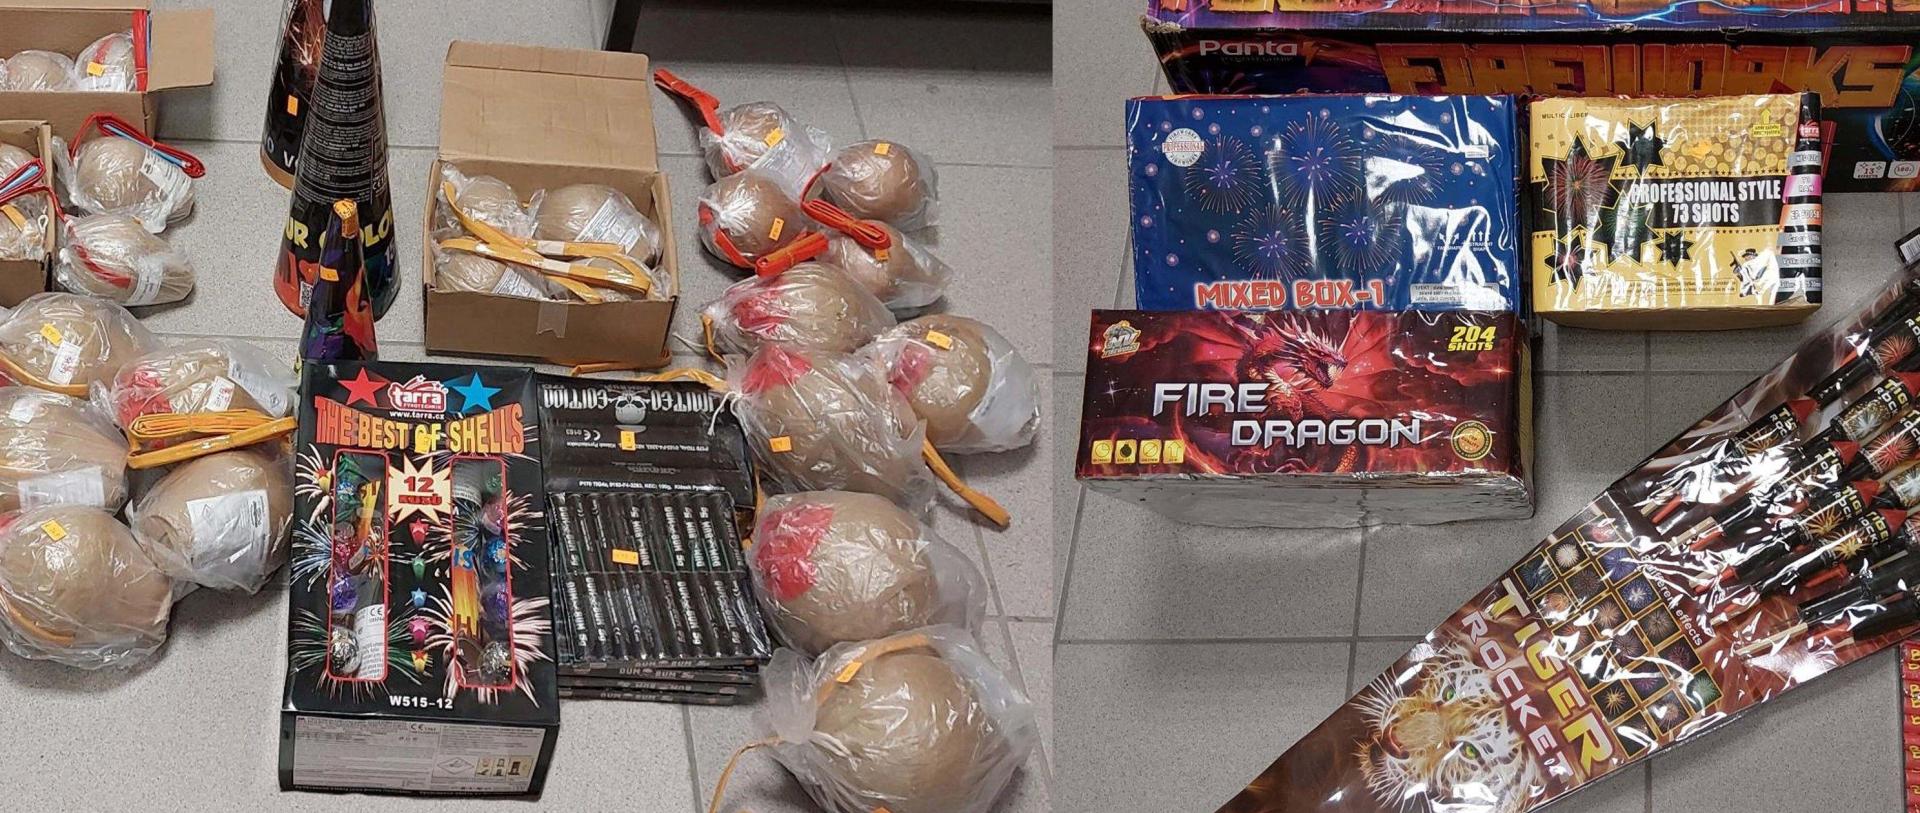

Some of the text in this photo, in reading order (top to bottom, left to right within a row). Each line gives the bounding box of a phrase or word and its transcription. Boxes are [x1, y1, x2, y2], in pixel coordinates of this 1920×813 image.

[1199, 40, 1298, 56] Panta
[1631, 179, 1781, 203] PROFESSIONAL STYLE
[1672, 202, 1739, 224] 73 SHOTS
[1197, 282, 1284, 308] MIXED
[1295, 281, 1385, 308] BOX-1
[1453, 325, 1496, 342] 204
[1448, 341, 1494, 352] SHOTS
[392, 388, 441, 404] tarra
[1153, 382, 1273, 417] FIRE
[315, 396, 524, 454] THE BEST OF SHELLS
[389, 411, 445, 421] www.tarra.cz
[1231, 418, 1423, 449] DRAGON
[403, 475, 434, 493] 12
[1676, 609, 1704, 646] effects
[1491, 577, 1615, 776] TIGER
[389, 695, 453, 710] W515-12
[1462, 610, 1575, 783] ROCKET
